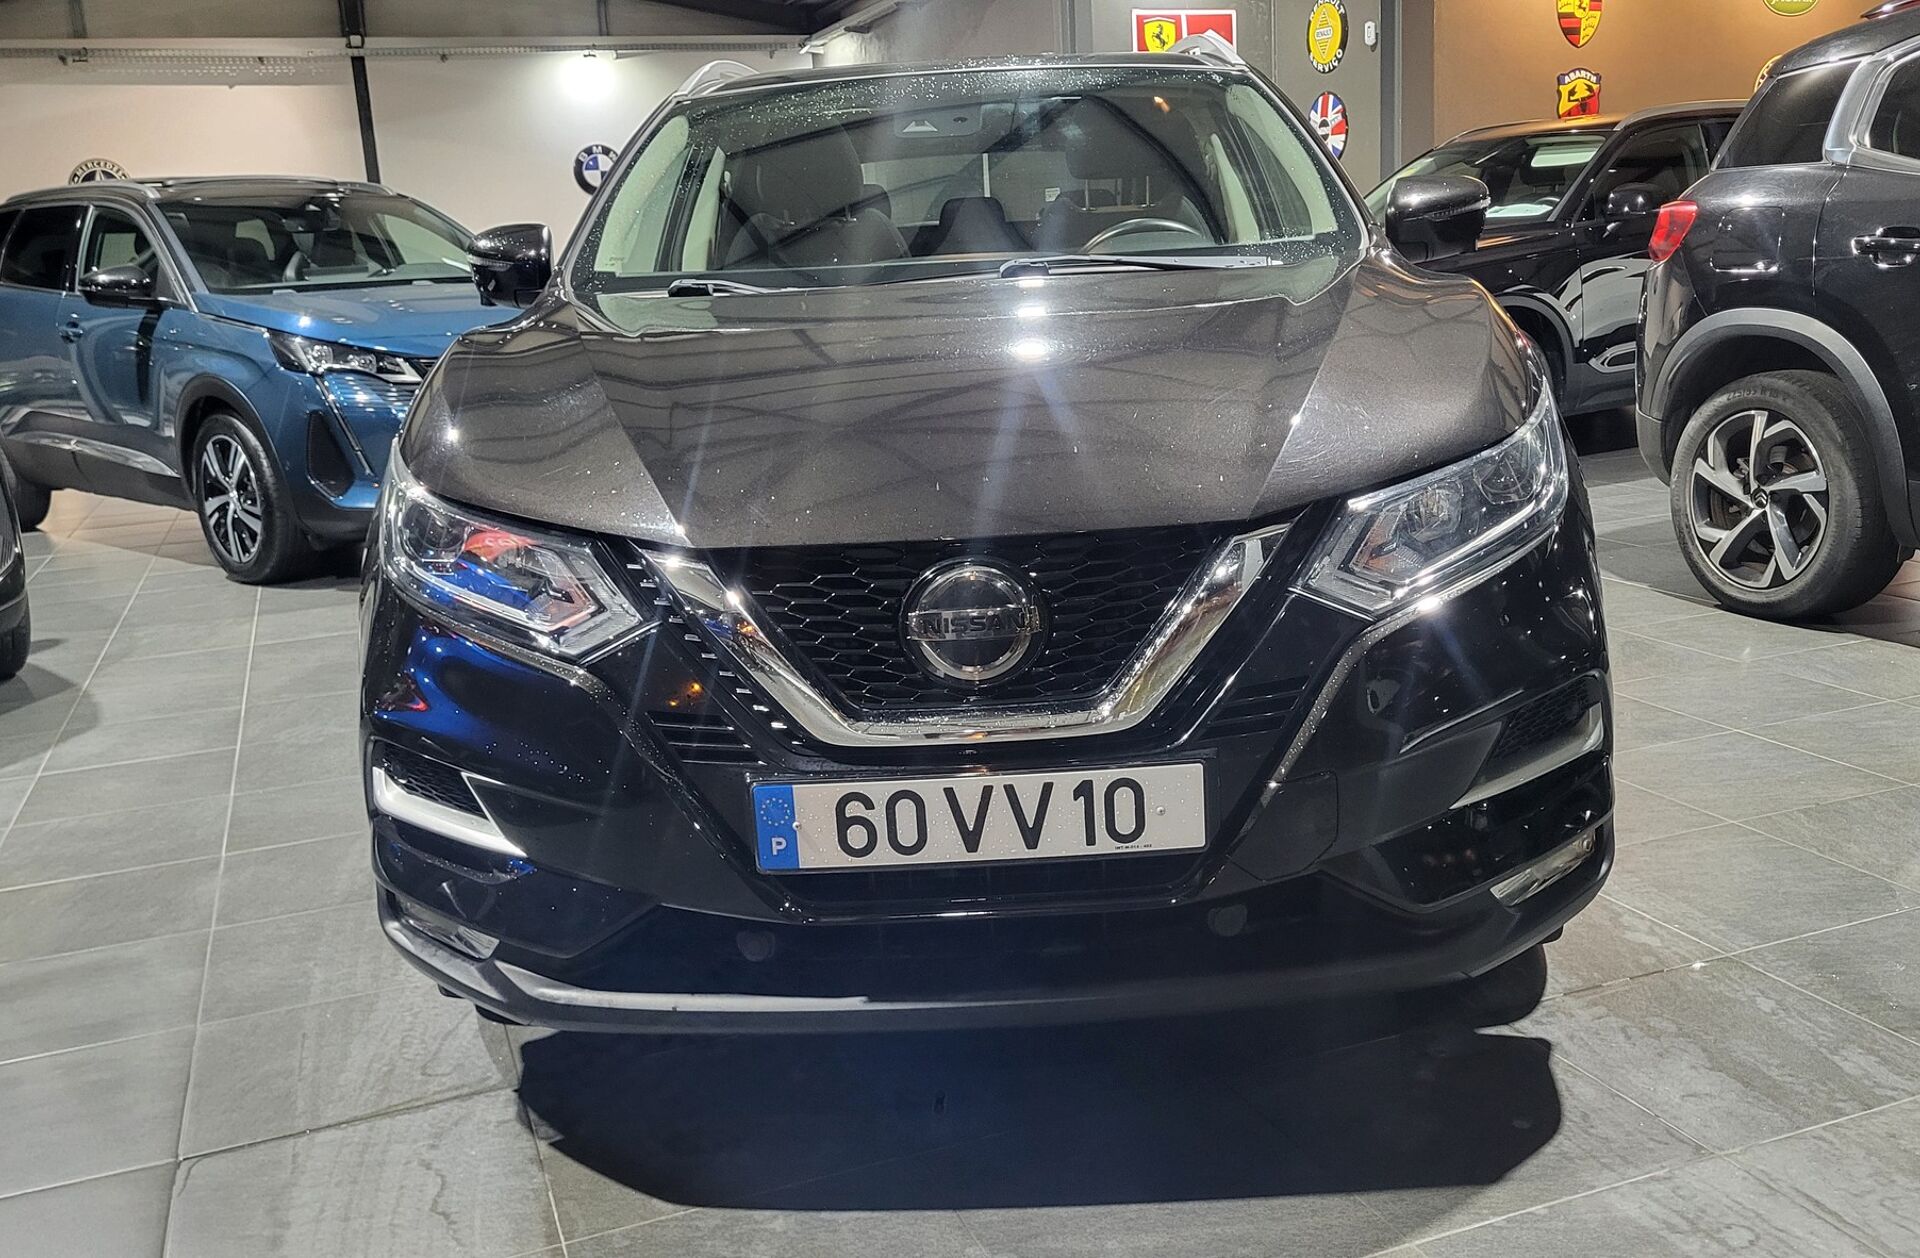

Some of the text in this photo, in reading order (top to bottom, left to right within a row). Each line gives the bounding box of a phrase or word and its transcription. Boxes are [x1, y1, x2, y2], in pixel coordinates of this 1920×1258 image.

[1309, 48, 1344, 72] SERVIÇO
[1564, 69, 1597, 84] ABARTH
[76, 160, 123, 178] MERCEDES
[922, 610, 1027, 637] NISSAN
[834, 776, 1147, 858] 60 VV 10
[771, 836, 787, 856] P
